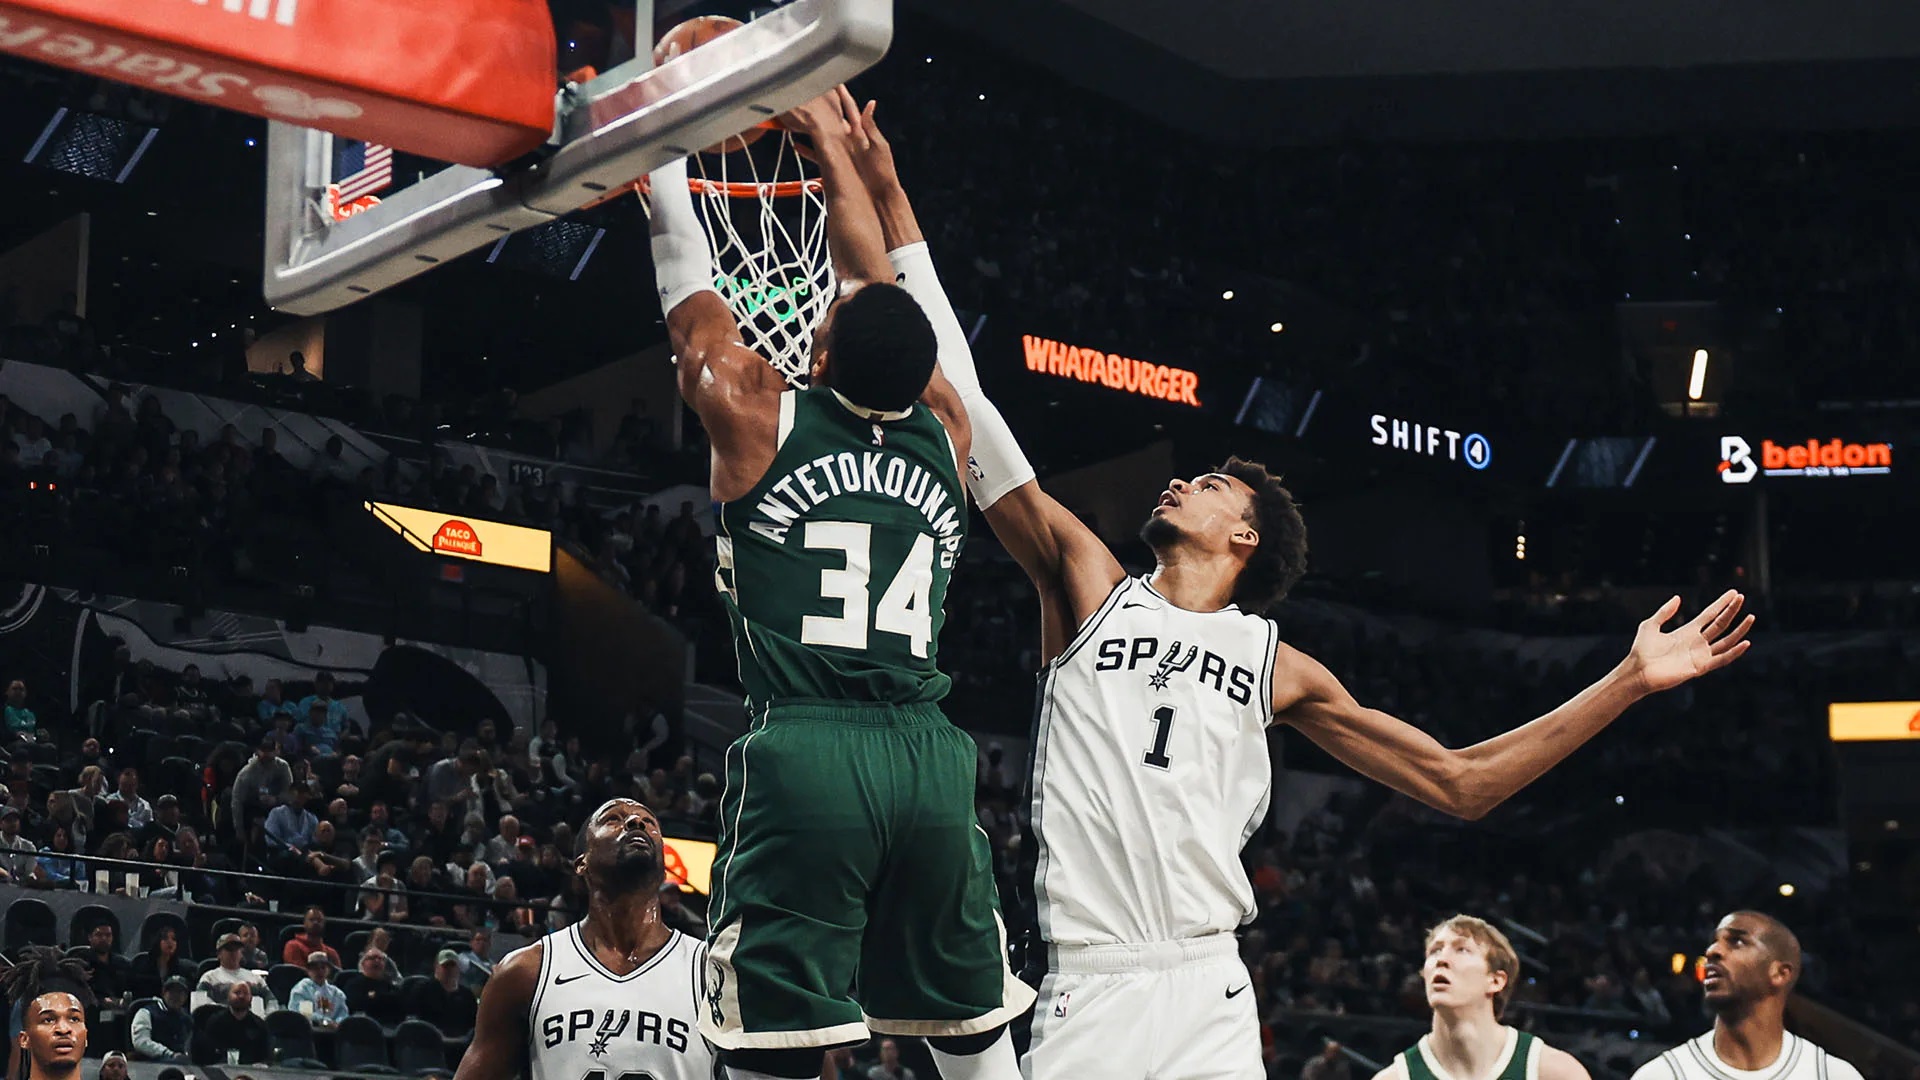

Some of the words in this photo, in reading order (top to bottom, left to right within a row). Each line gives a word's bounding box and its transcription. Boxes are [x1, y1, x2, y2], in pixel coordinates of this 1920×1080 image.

[1022, 334, 1201, 407] WHATABURGER
[1762, 438, 1891, 469] beldon
[446, 527, 471, 540] TACO
[749, 451, 963, 569] ANTETOKOUNMPO
[800, 521, 935, 659] 34
[1095, 636, 1256, 706] SPURS
[1141, 703, 1177, 772] 1
[542, 1008, 690, 1058] SPURS
